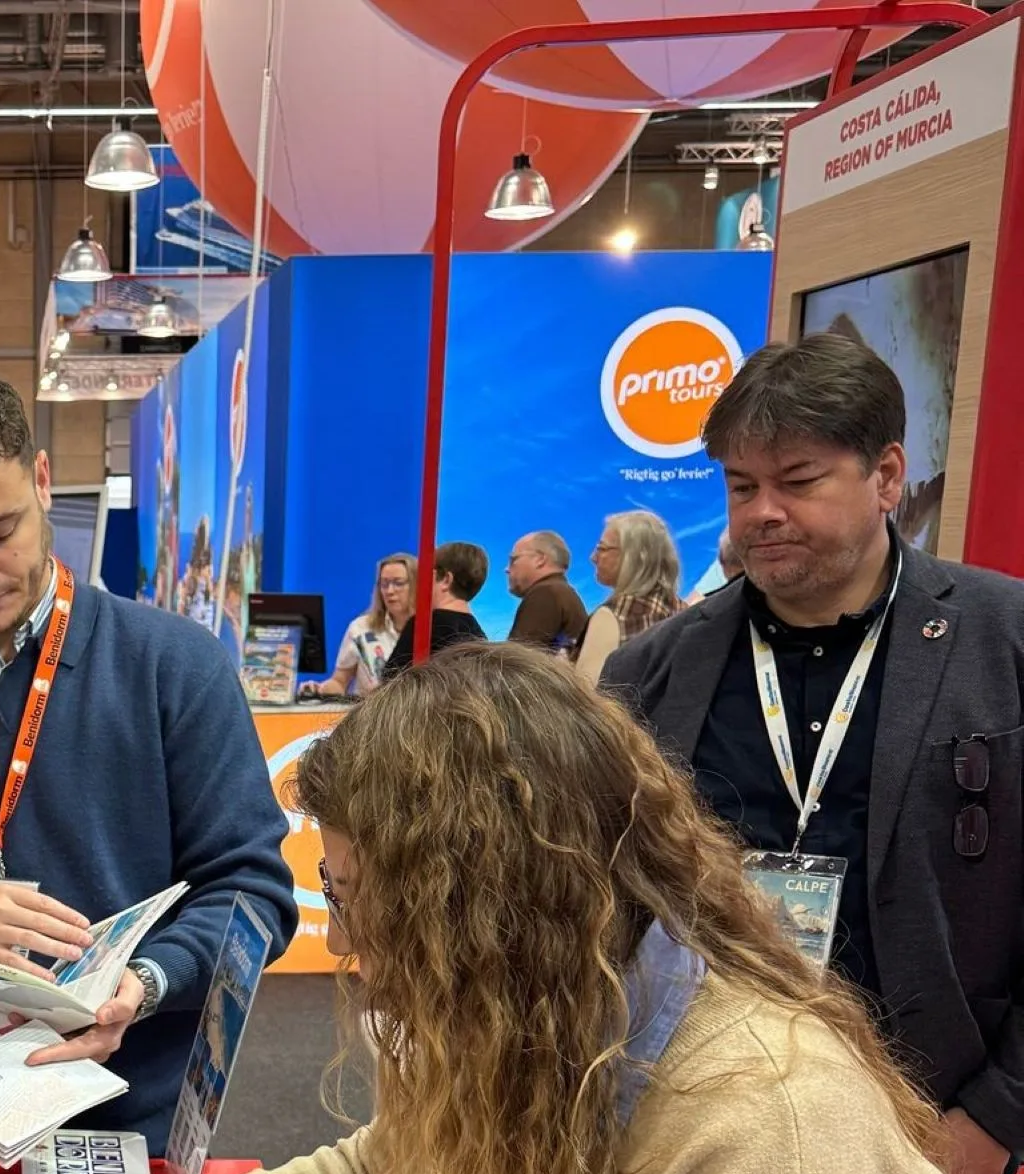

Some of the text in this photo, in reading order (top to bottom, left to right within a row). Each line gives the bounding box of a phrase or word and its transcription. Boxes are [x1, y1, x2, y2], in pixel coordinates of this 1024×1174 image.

[840, 80, 941, 143] COSTA CÁLIDA,
[824, 108, 953, 182] REGION OF MURCIA
[618, 358, 721, 406] primo
[670, 383, 725, 404] tours
[45, 612, 68, 666] Benidorm
[23, 693, 46, 748] Benidorm
[785, 879, 829, 893] CALPE
